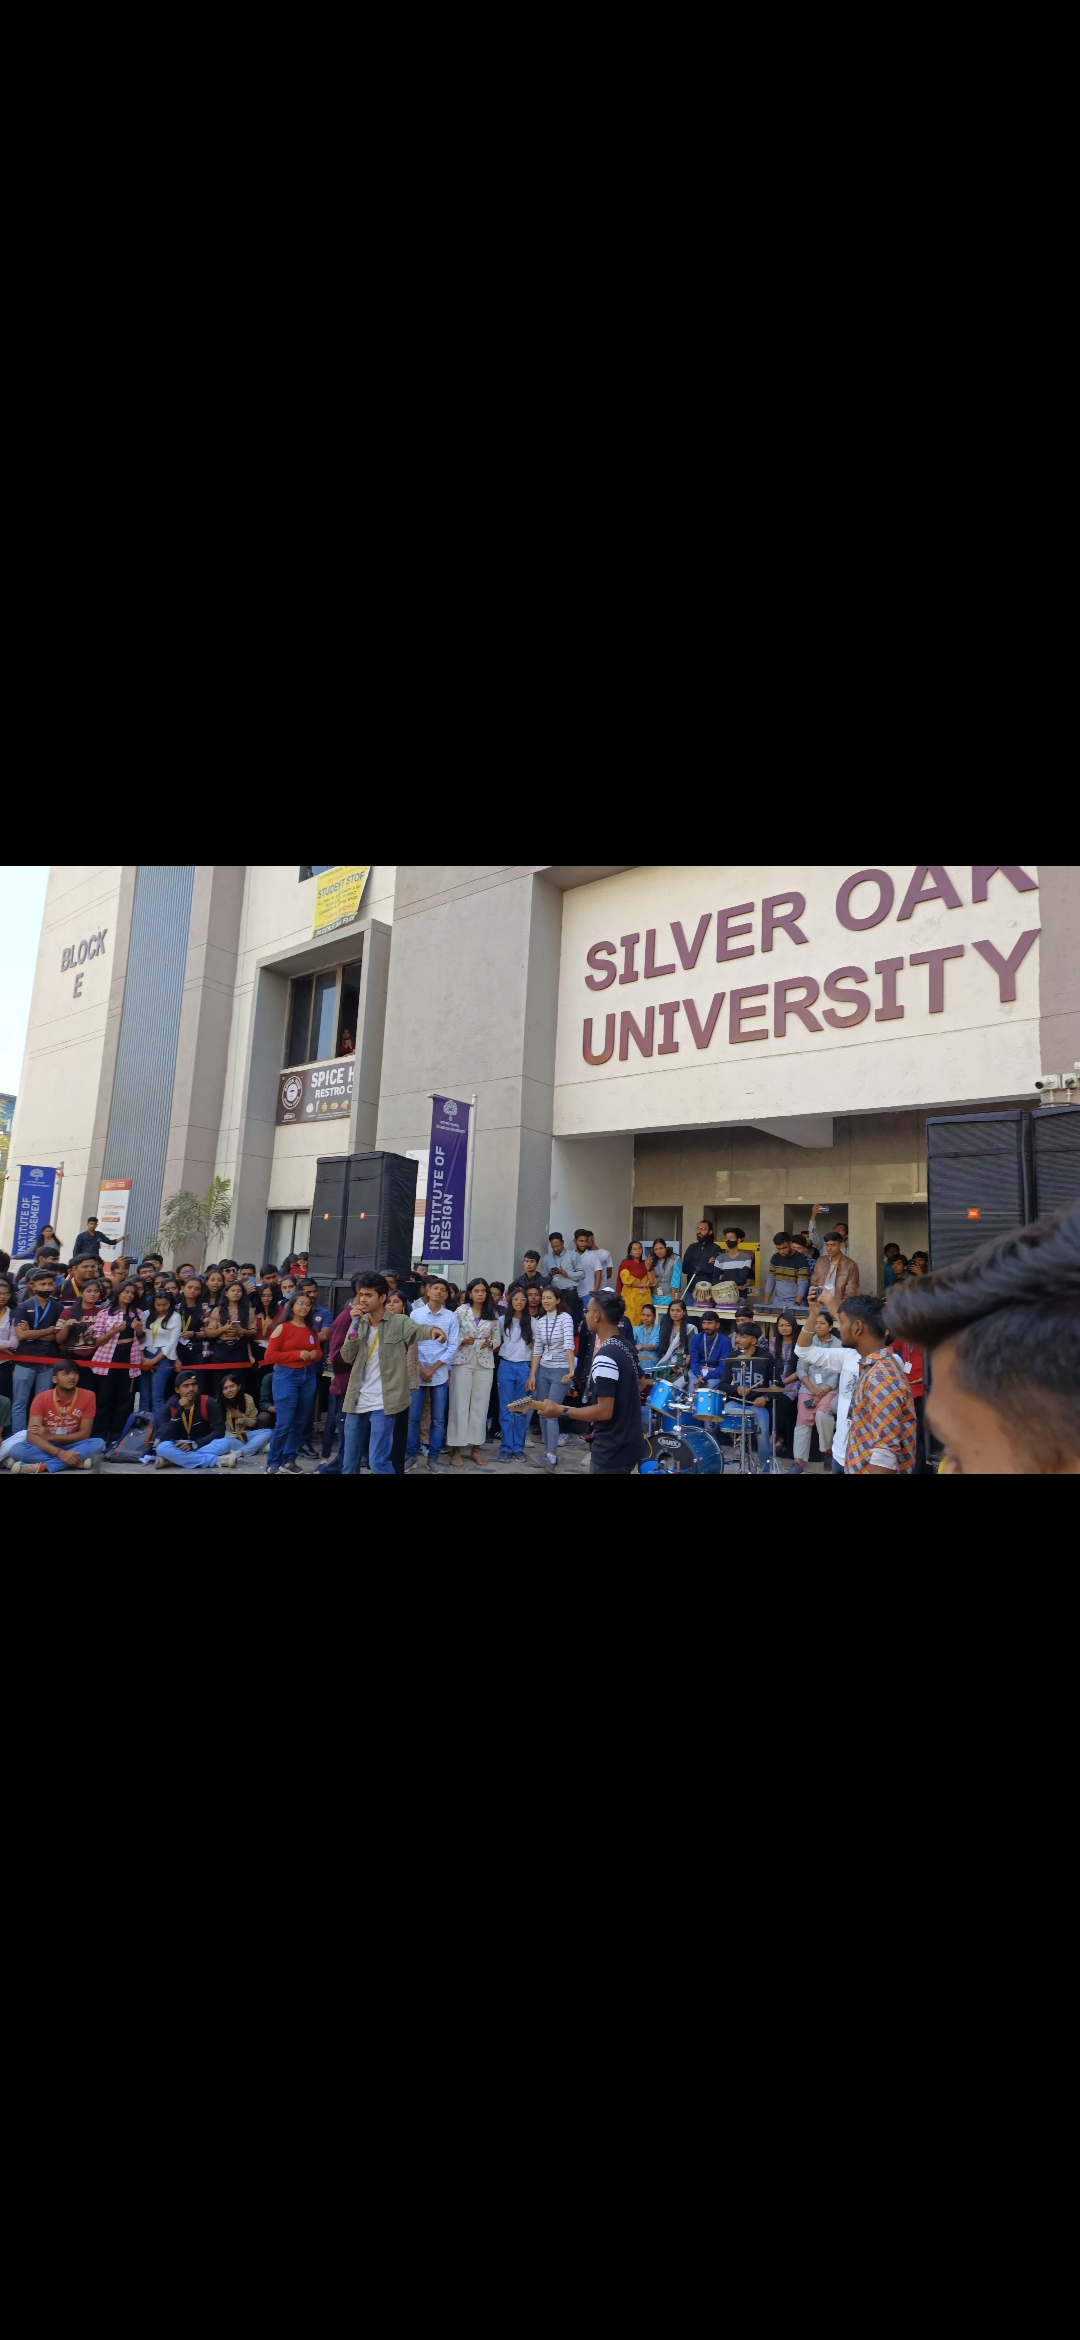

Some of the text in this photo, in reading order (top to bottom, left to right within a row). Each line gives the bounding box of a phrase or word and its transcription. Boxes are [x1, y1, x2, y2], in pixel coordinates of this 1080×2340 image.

[317, 878, 346, 899] STUDENT
[60, 928, 108, 972] BLOCK
[585, 866, 1039, 991] SILVER OAK
[73, 972, 84, 998] E
[582, 928, 1042, 1065] UNIVERSITY
[311, 1067, 345, 1088] SPICE
[315, 1086, 345, 1099] RESTRO
[21, 1197, 32, 1209] OF
[429, 1145, 445, 1250] INSTITUTE OF
[26, 1194, 41, 1252] ANAGEMENT
[440, 1193, 453, 1250] DESIGN
